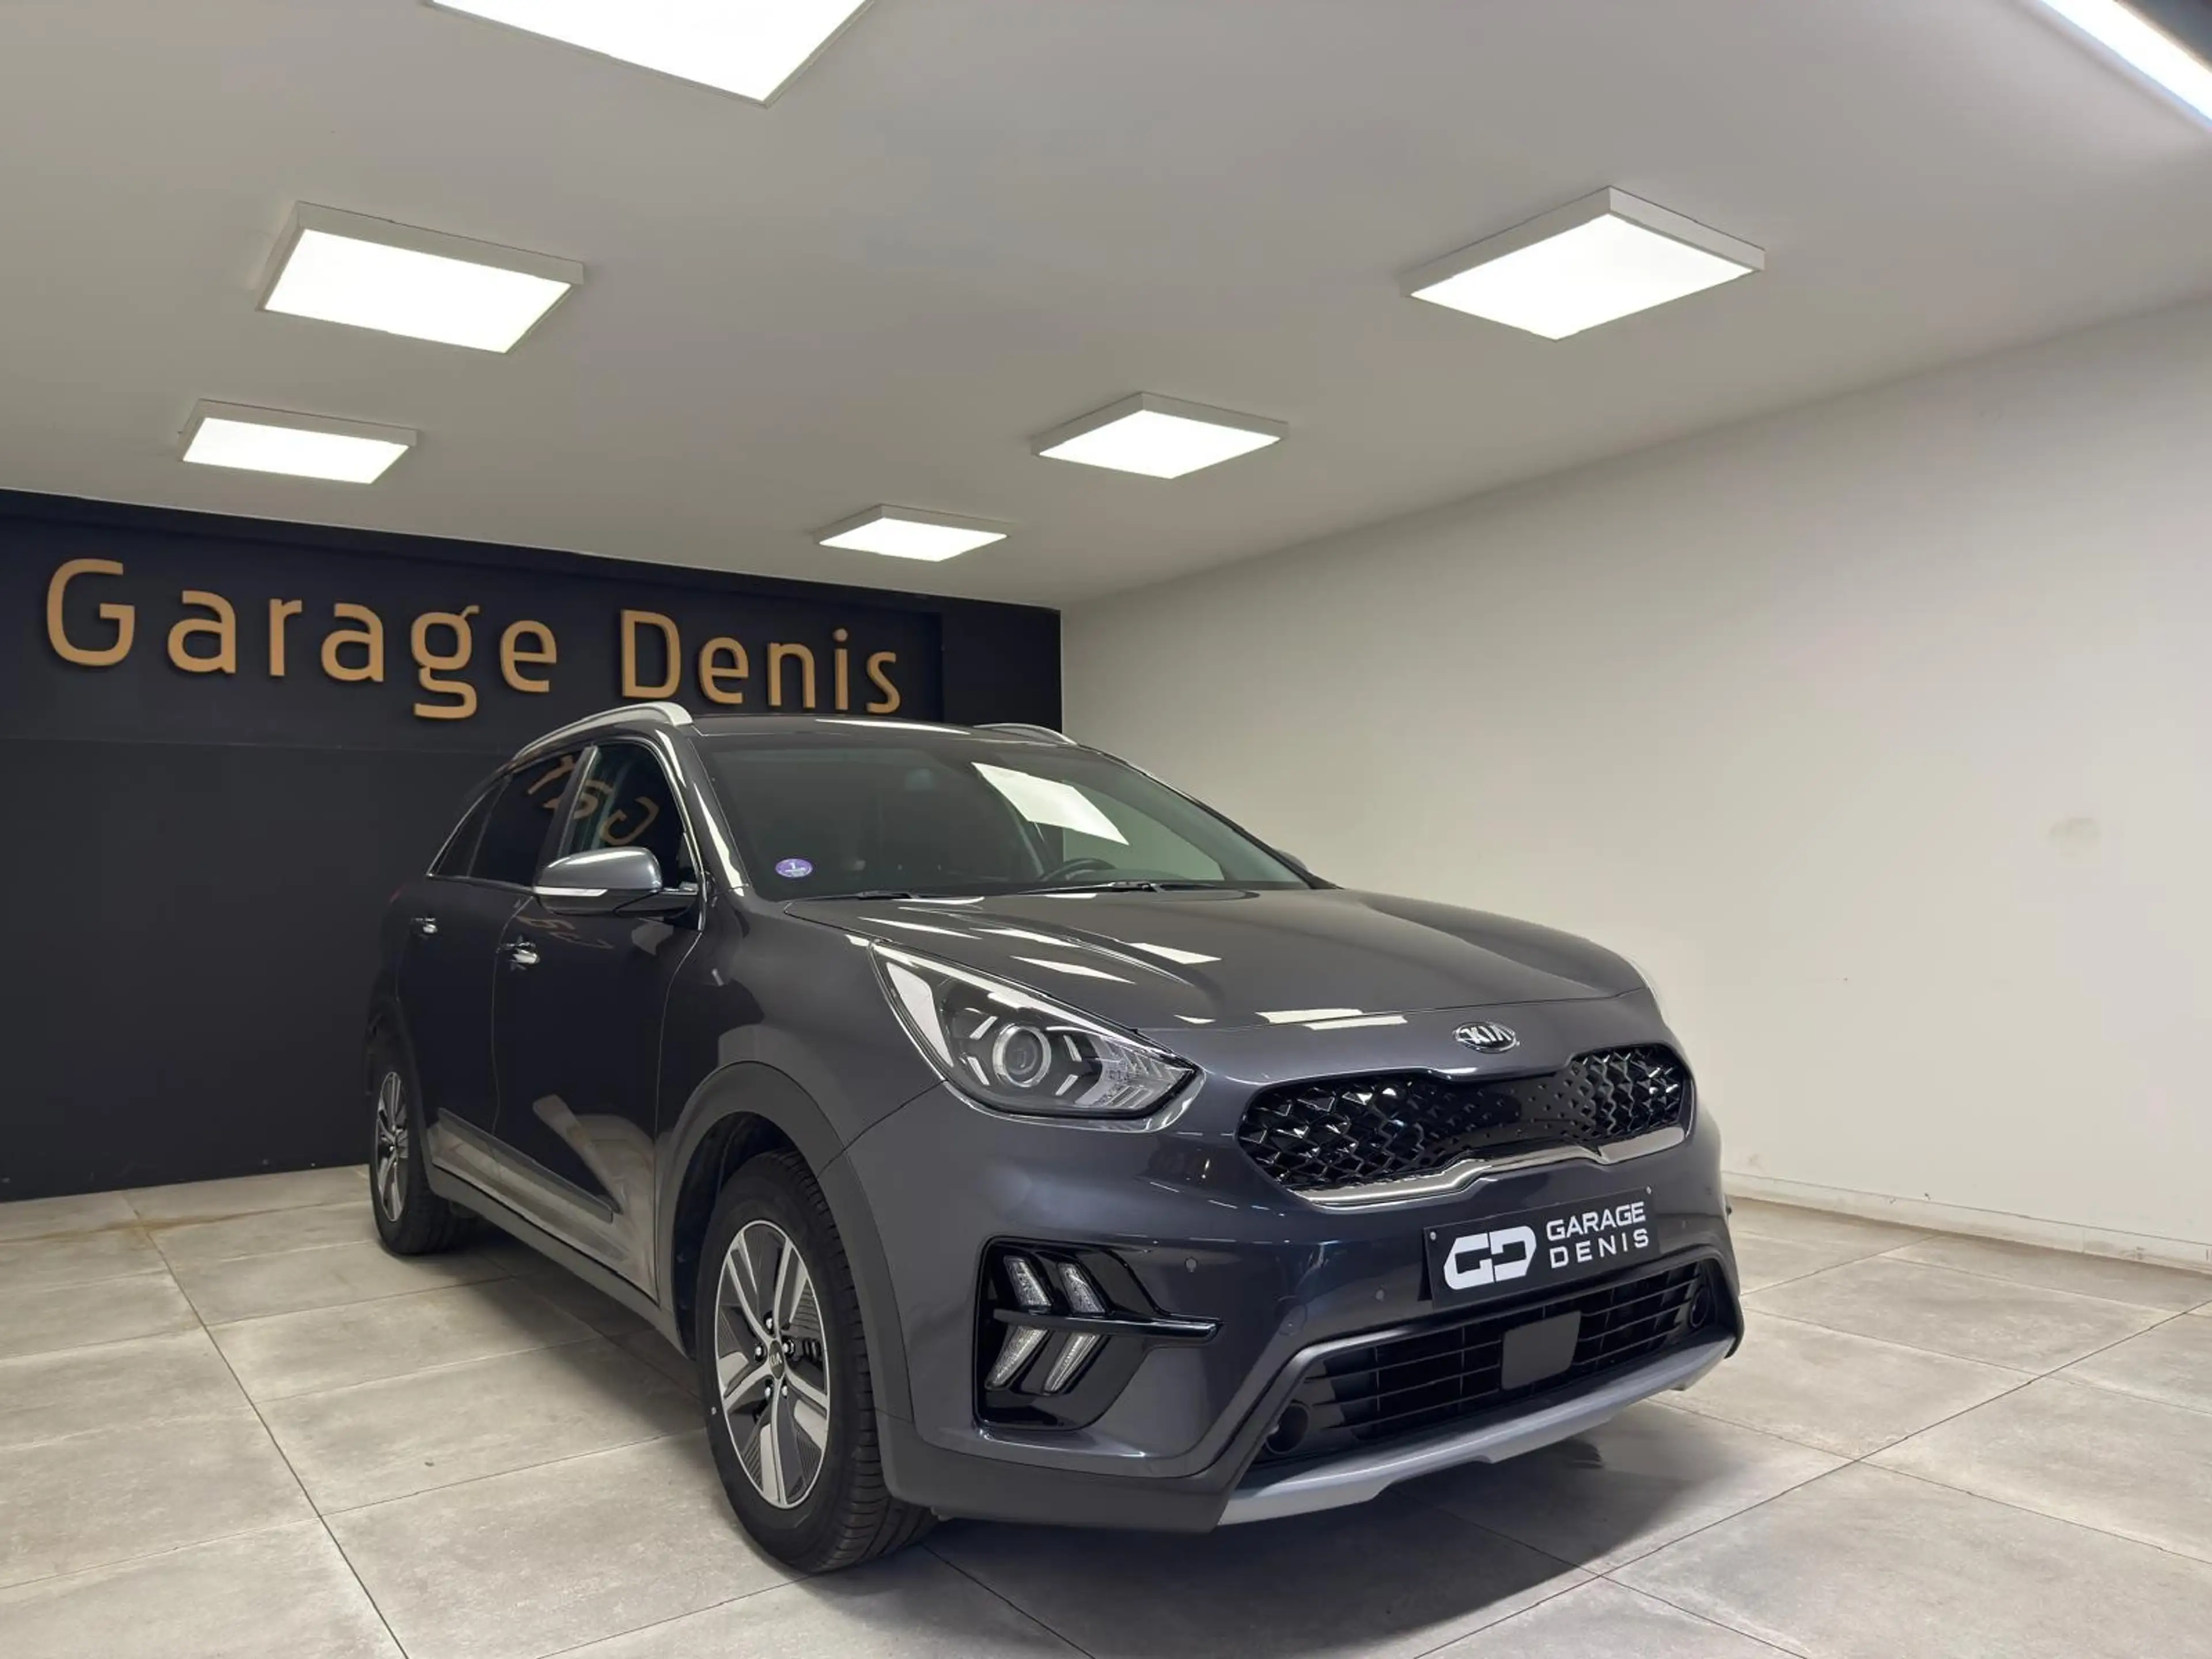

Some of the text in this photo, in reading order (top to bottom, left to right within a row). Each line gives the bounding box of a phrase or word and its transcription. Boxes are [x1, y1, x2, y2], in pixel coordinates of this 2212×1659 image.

[47, 559, 902, 719] Garage Denis
[1546, 1201, 1646, 1241] GARAGE
[1550, 1228, 1649, 1269] DENIS
